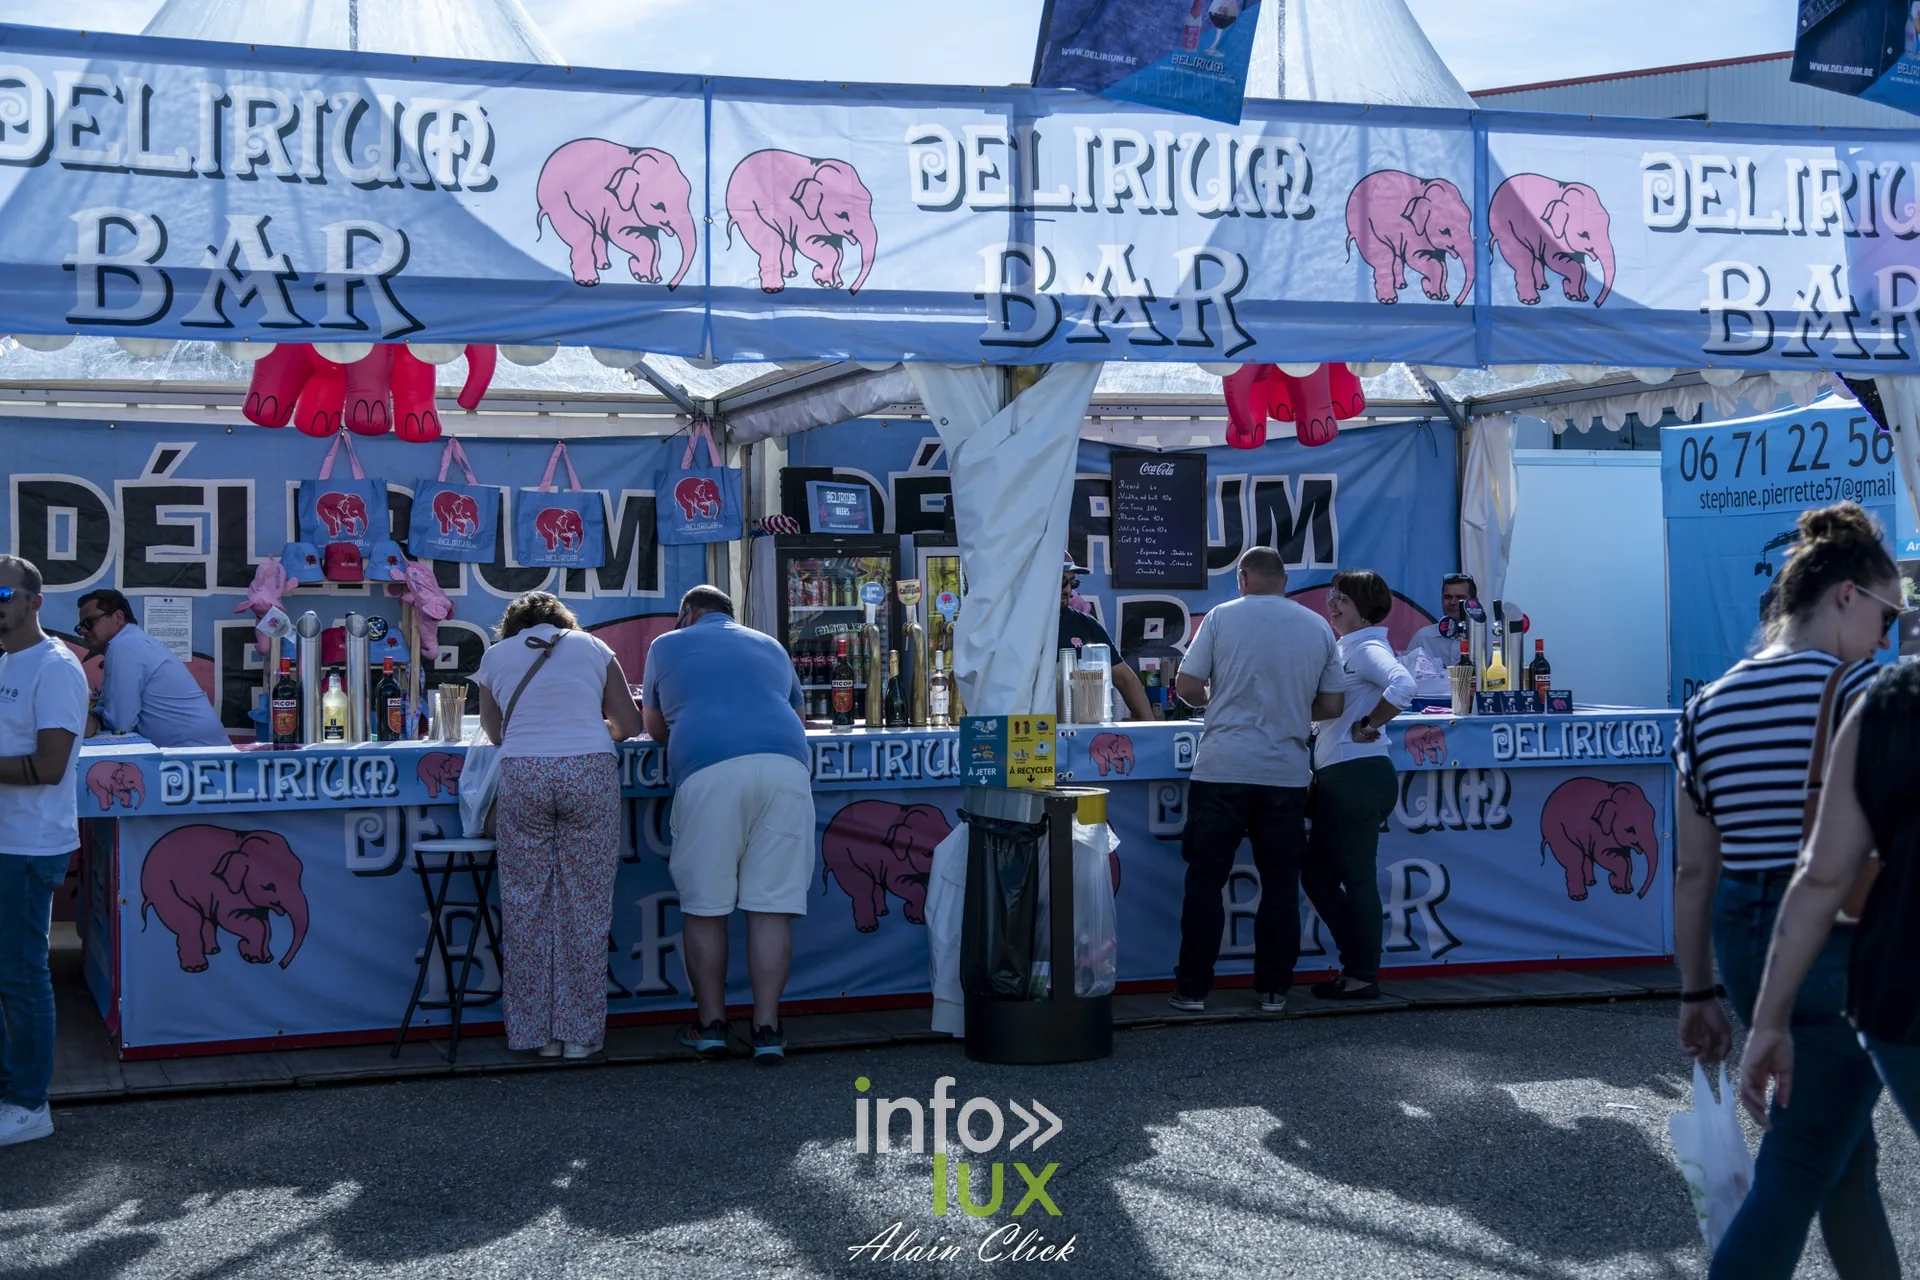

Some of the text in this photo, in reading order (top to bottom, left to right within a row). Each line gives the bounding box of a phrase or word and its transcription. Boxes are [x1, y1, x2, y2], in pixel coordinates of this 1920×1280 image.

[1061, 47, 1138, 66] WWW.DELIRIUM.BE
[1809, 61, 1874, 77] WWW.DELIRIUM.BE
[0, 65, 499, 192] DELIRIUM
[905, 123, 1316, 220] DELIRIUM
[63, 206, 426, 340] BAR
[973, 242, 1256, 358] BAR
[1680, 416, 1894, 482] 06 71 22 56
[1700, 470, 1896, 512] stephane.pierrette57@gmail
[807, 737, 960, 783] ELIRIU
[1491, 719, 1666, 761] DELIRIUM
[159, 755, 401, 805] DELIRIUM
[968, 767, 997, 776] À JETER
[1009, 766, 1053, 775] À RECYCLER
